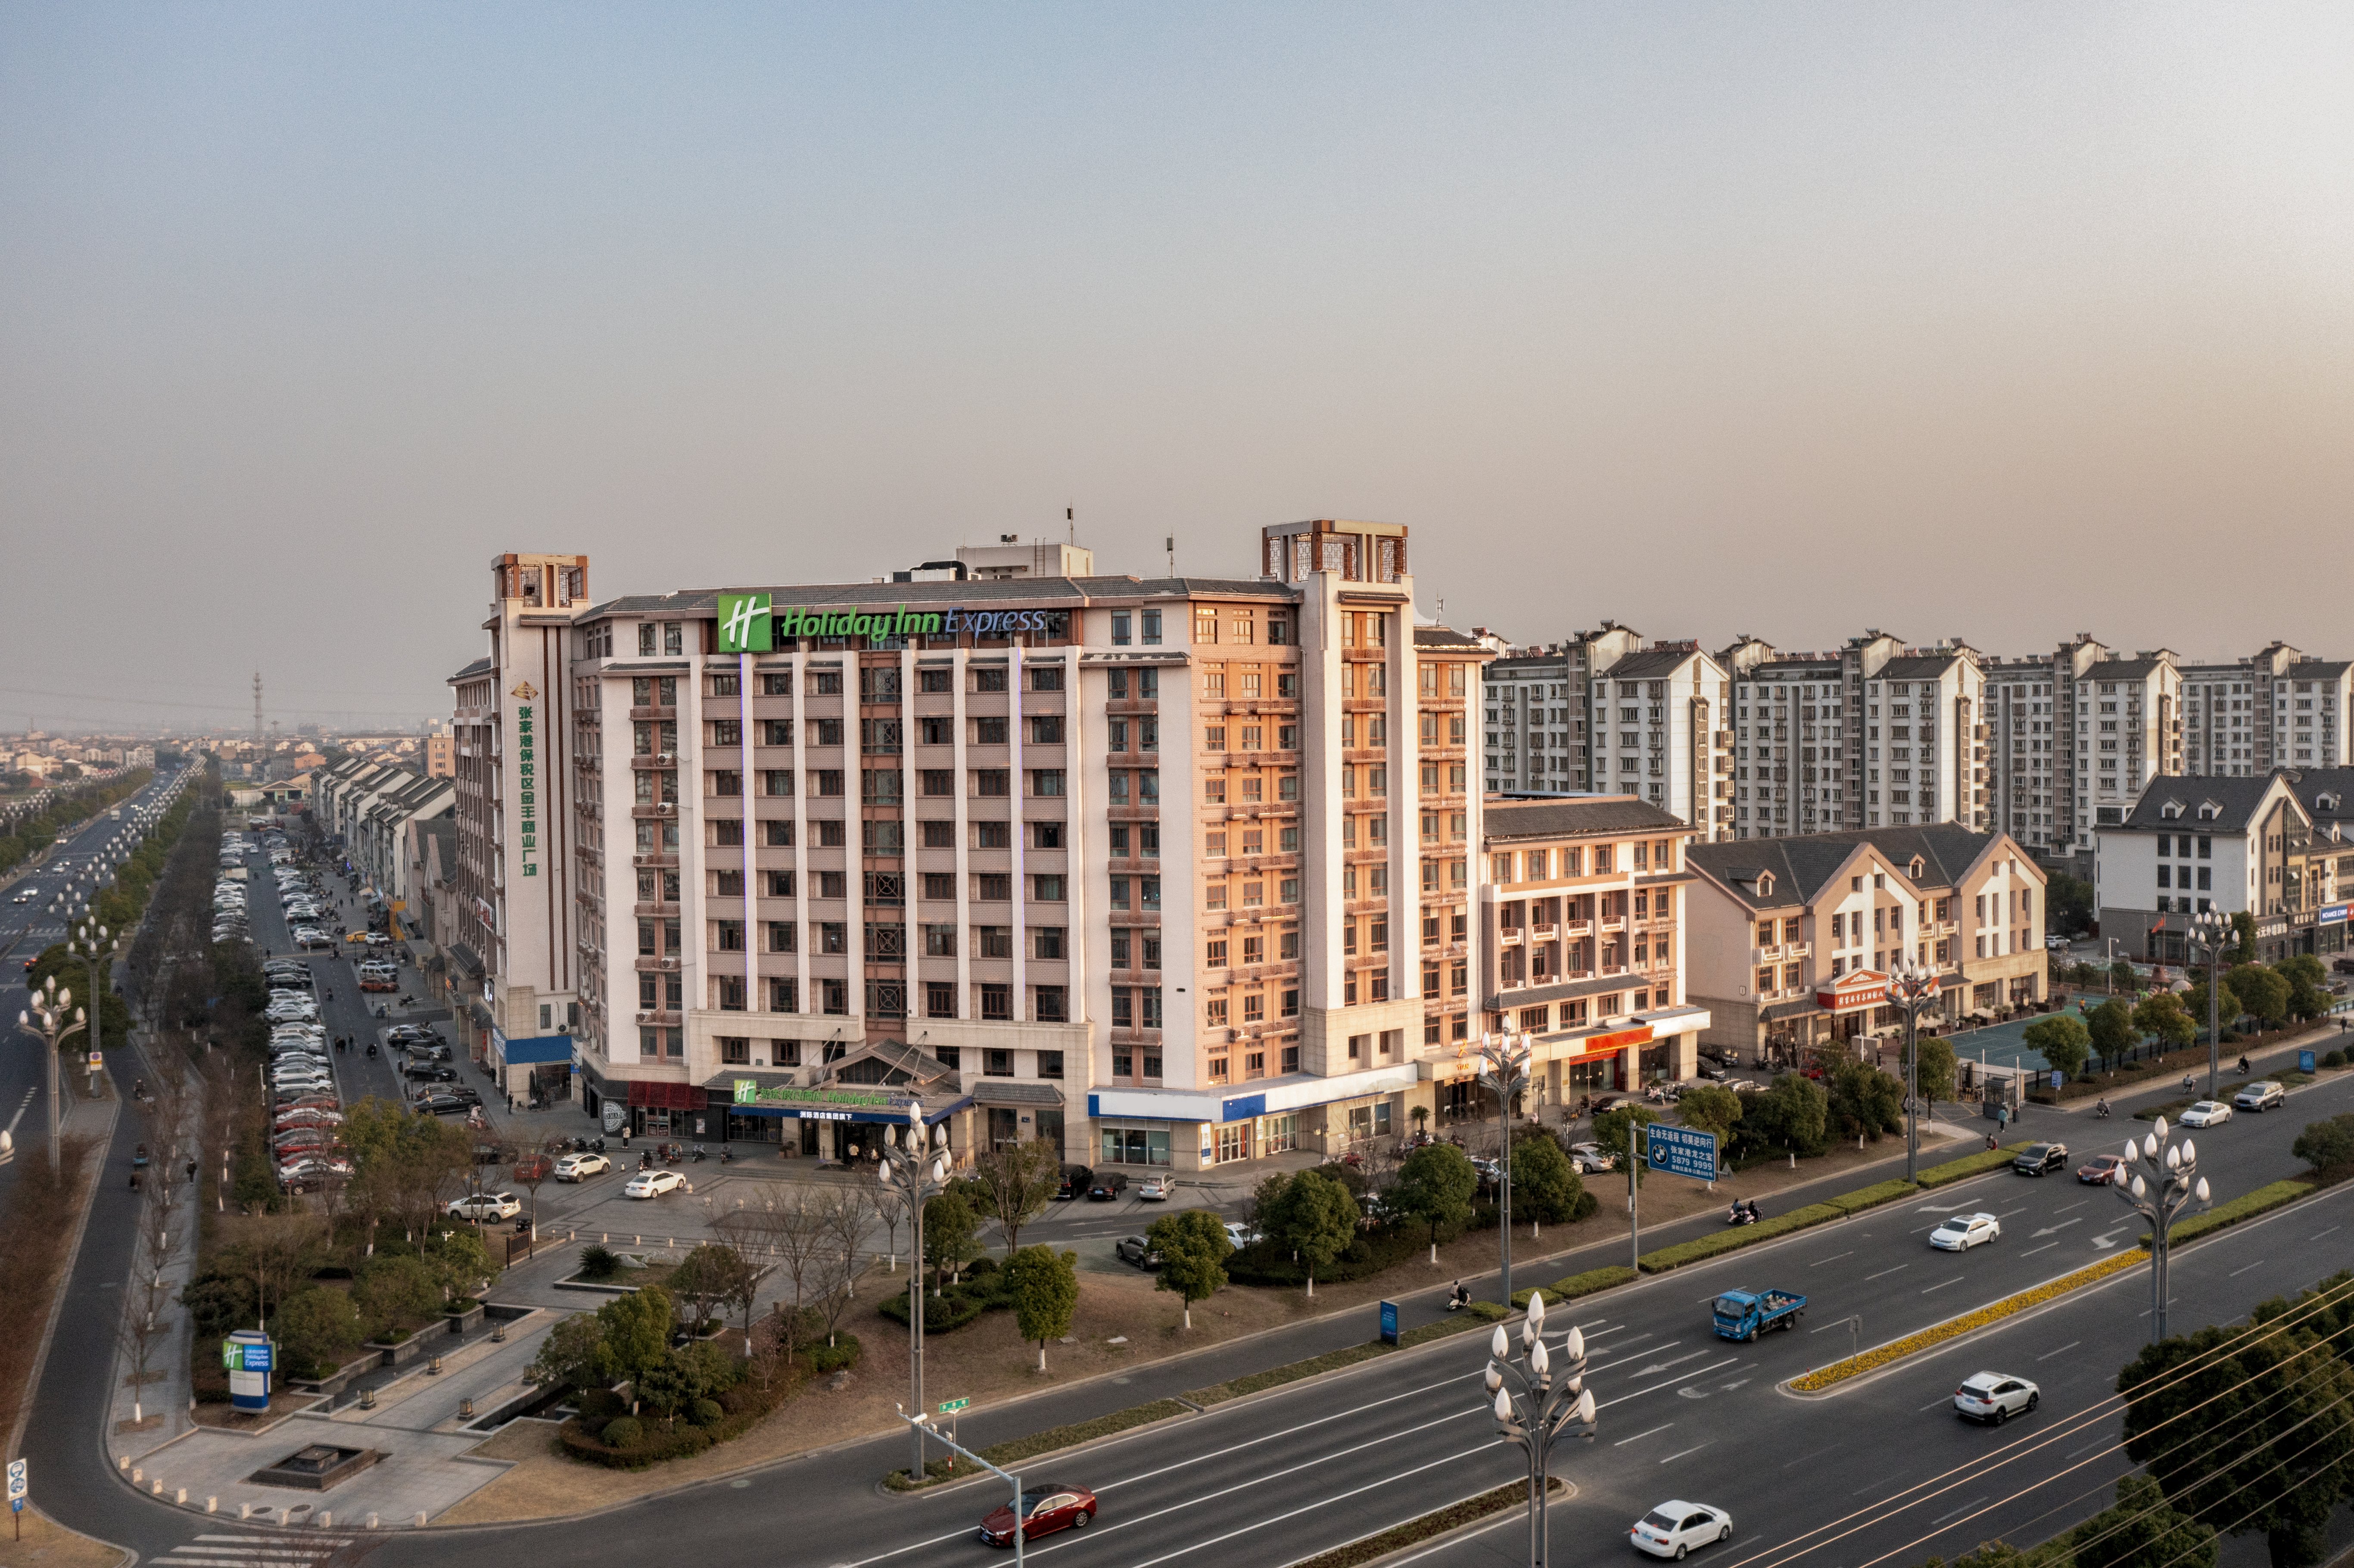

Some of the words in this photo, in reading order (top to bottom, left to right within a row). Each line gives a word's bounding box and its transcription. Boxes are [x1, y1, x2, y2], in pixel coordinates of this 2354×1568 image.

[782, 606, 892, 642] Holiday
[895, 604, 940, 634] Inn
[945, 606, 1045, 638] Express
[800, 1111, 853, 1120] 洲际酒店集团旗下
[1650, 1128, 1679, 1142] 生命无返程
[1682, 1134, 1712, 1148] 切莫逆向行
[1671, 1145, 1713, 1161] 张家港龙之宝
[1672, 1156, 1690, 1166] 5879
[1693, 1160, 1713, 1171] 9999
[245, 1359, 269, 1367] Express
